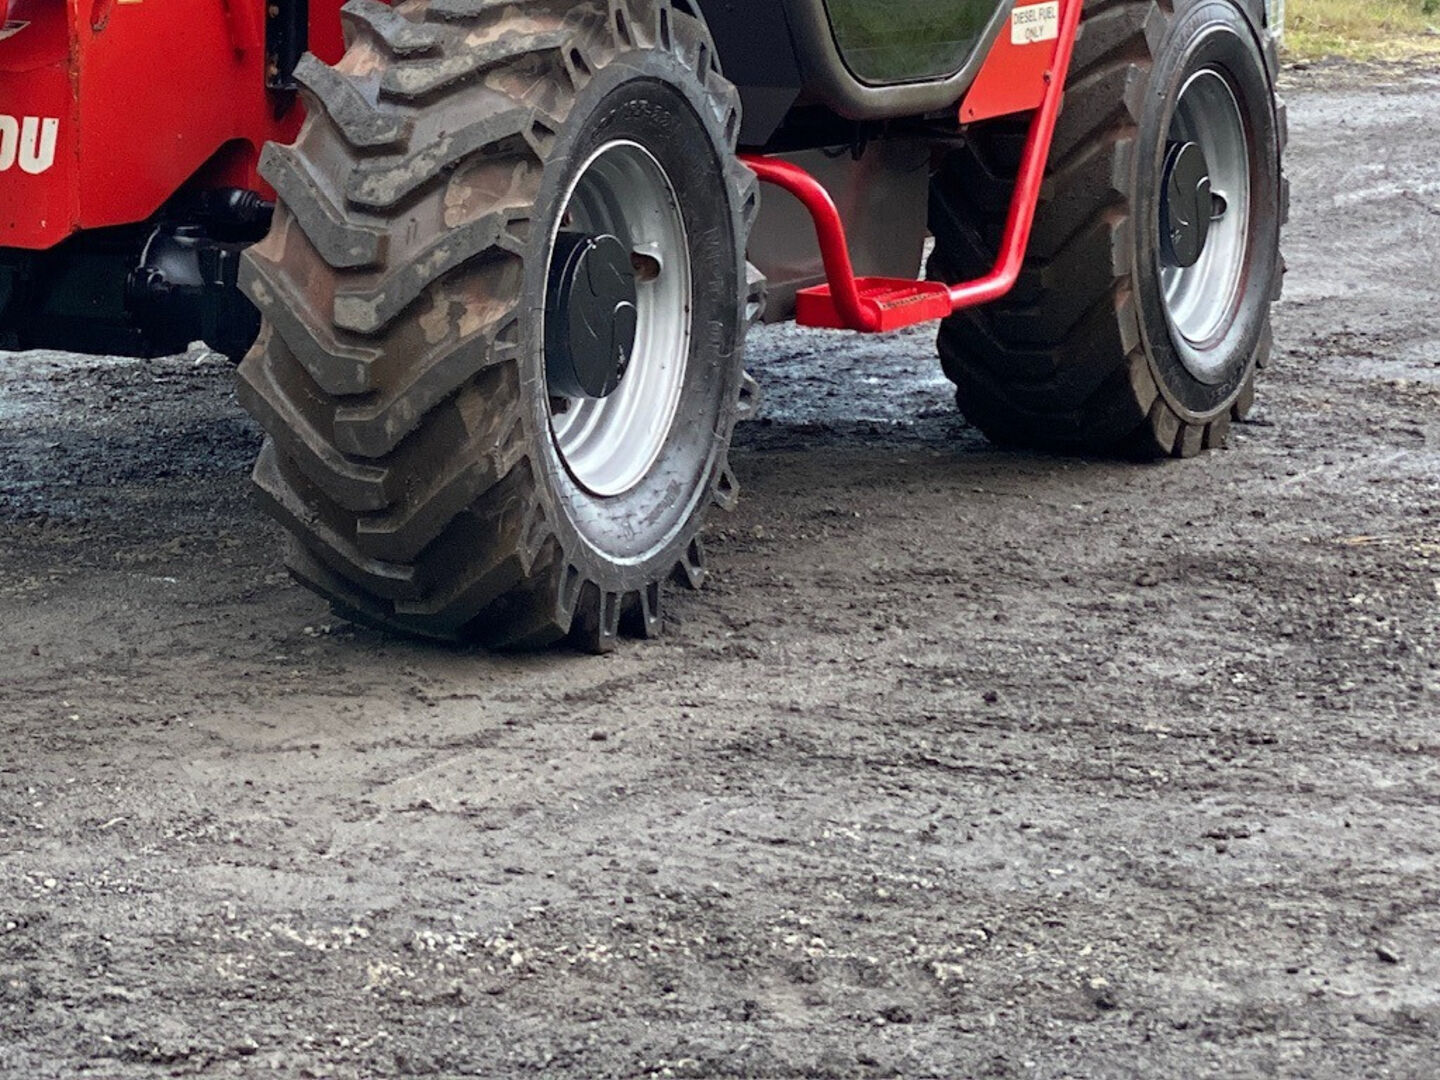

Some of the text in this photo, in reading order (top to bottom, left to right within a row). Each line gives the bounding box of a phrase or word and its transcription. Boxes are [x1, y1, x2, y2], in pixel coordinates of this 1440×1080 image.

[1013, 6, 1056, 25] DIESEL FUEL
[1024, 25, 1044, 39] ONLY
